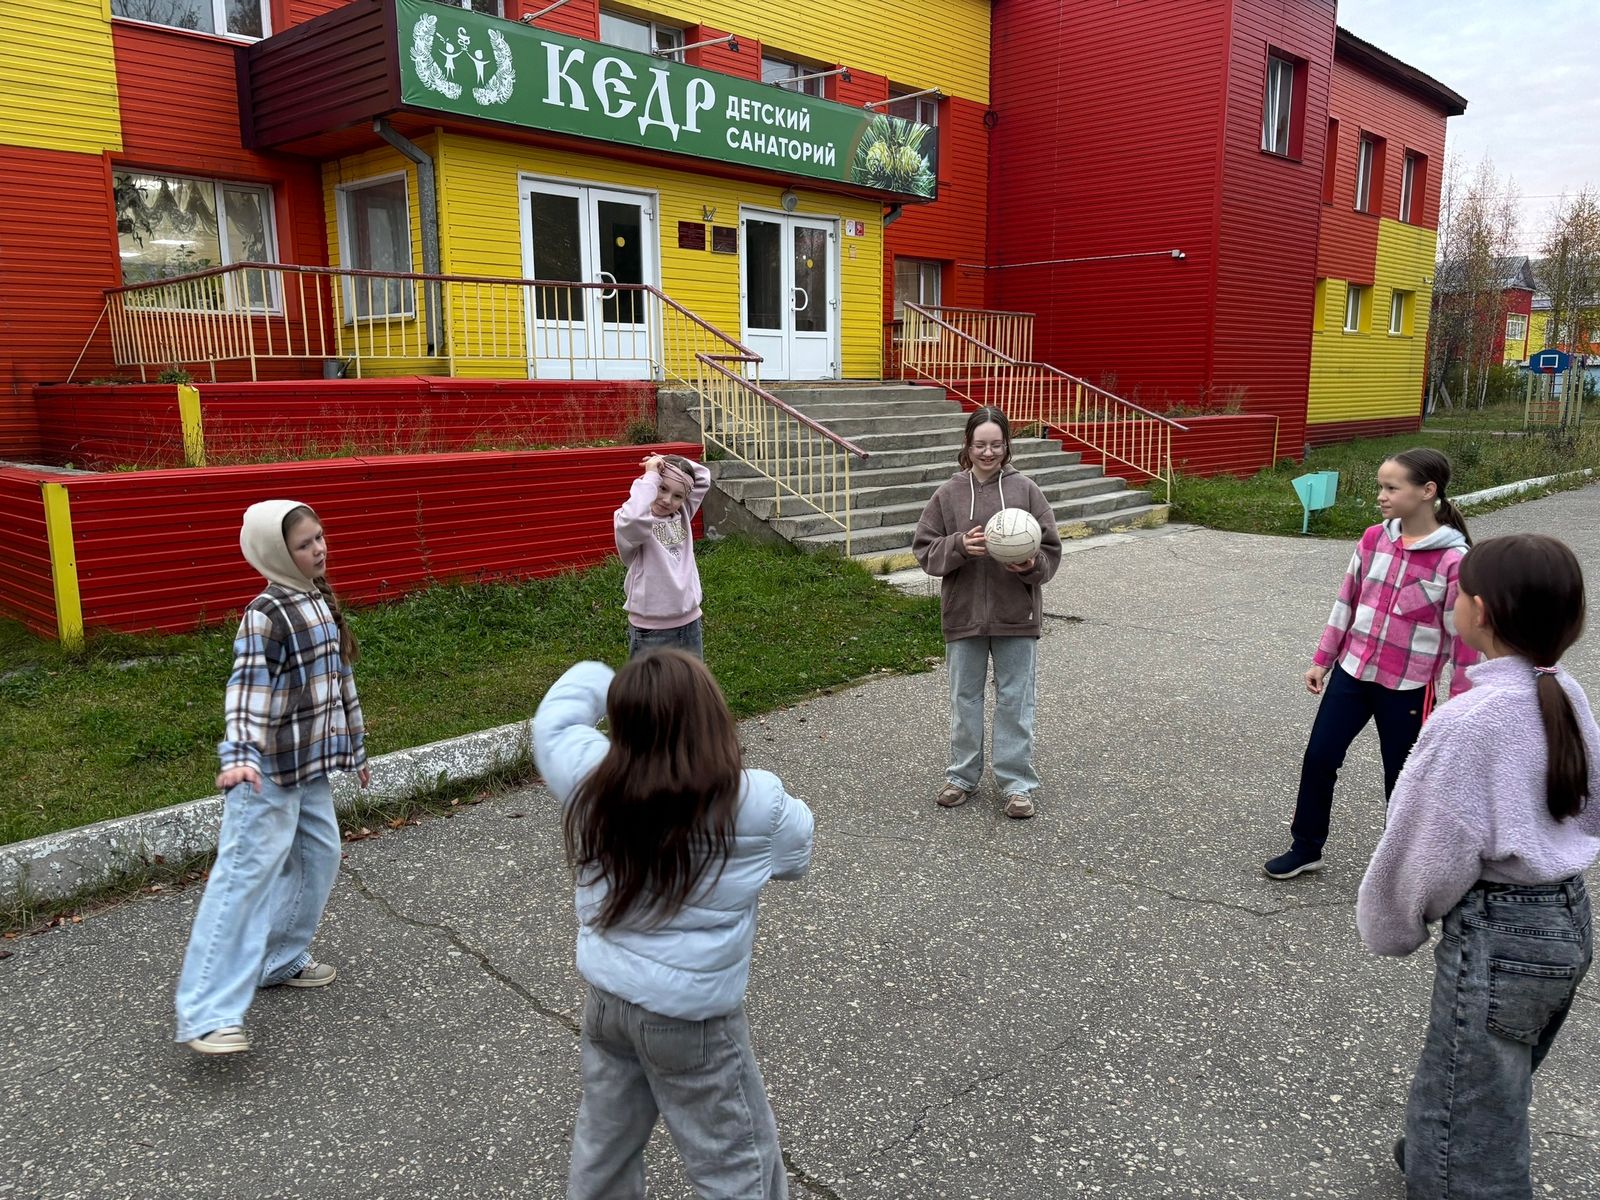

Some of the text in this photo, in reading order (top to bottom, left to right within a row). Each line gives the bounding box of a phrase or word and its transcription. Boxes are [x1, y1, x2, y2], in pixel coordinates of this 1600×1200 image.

[540, 41, 716, 142] КЕДР
[725, 95, 810, 133] ДЕТСКИЙ
[726, 127, 836, 167] САНАТОРИЙ
